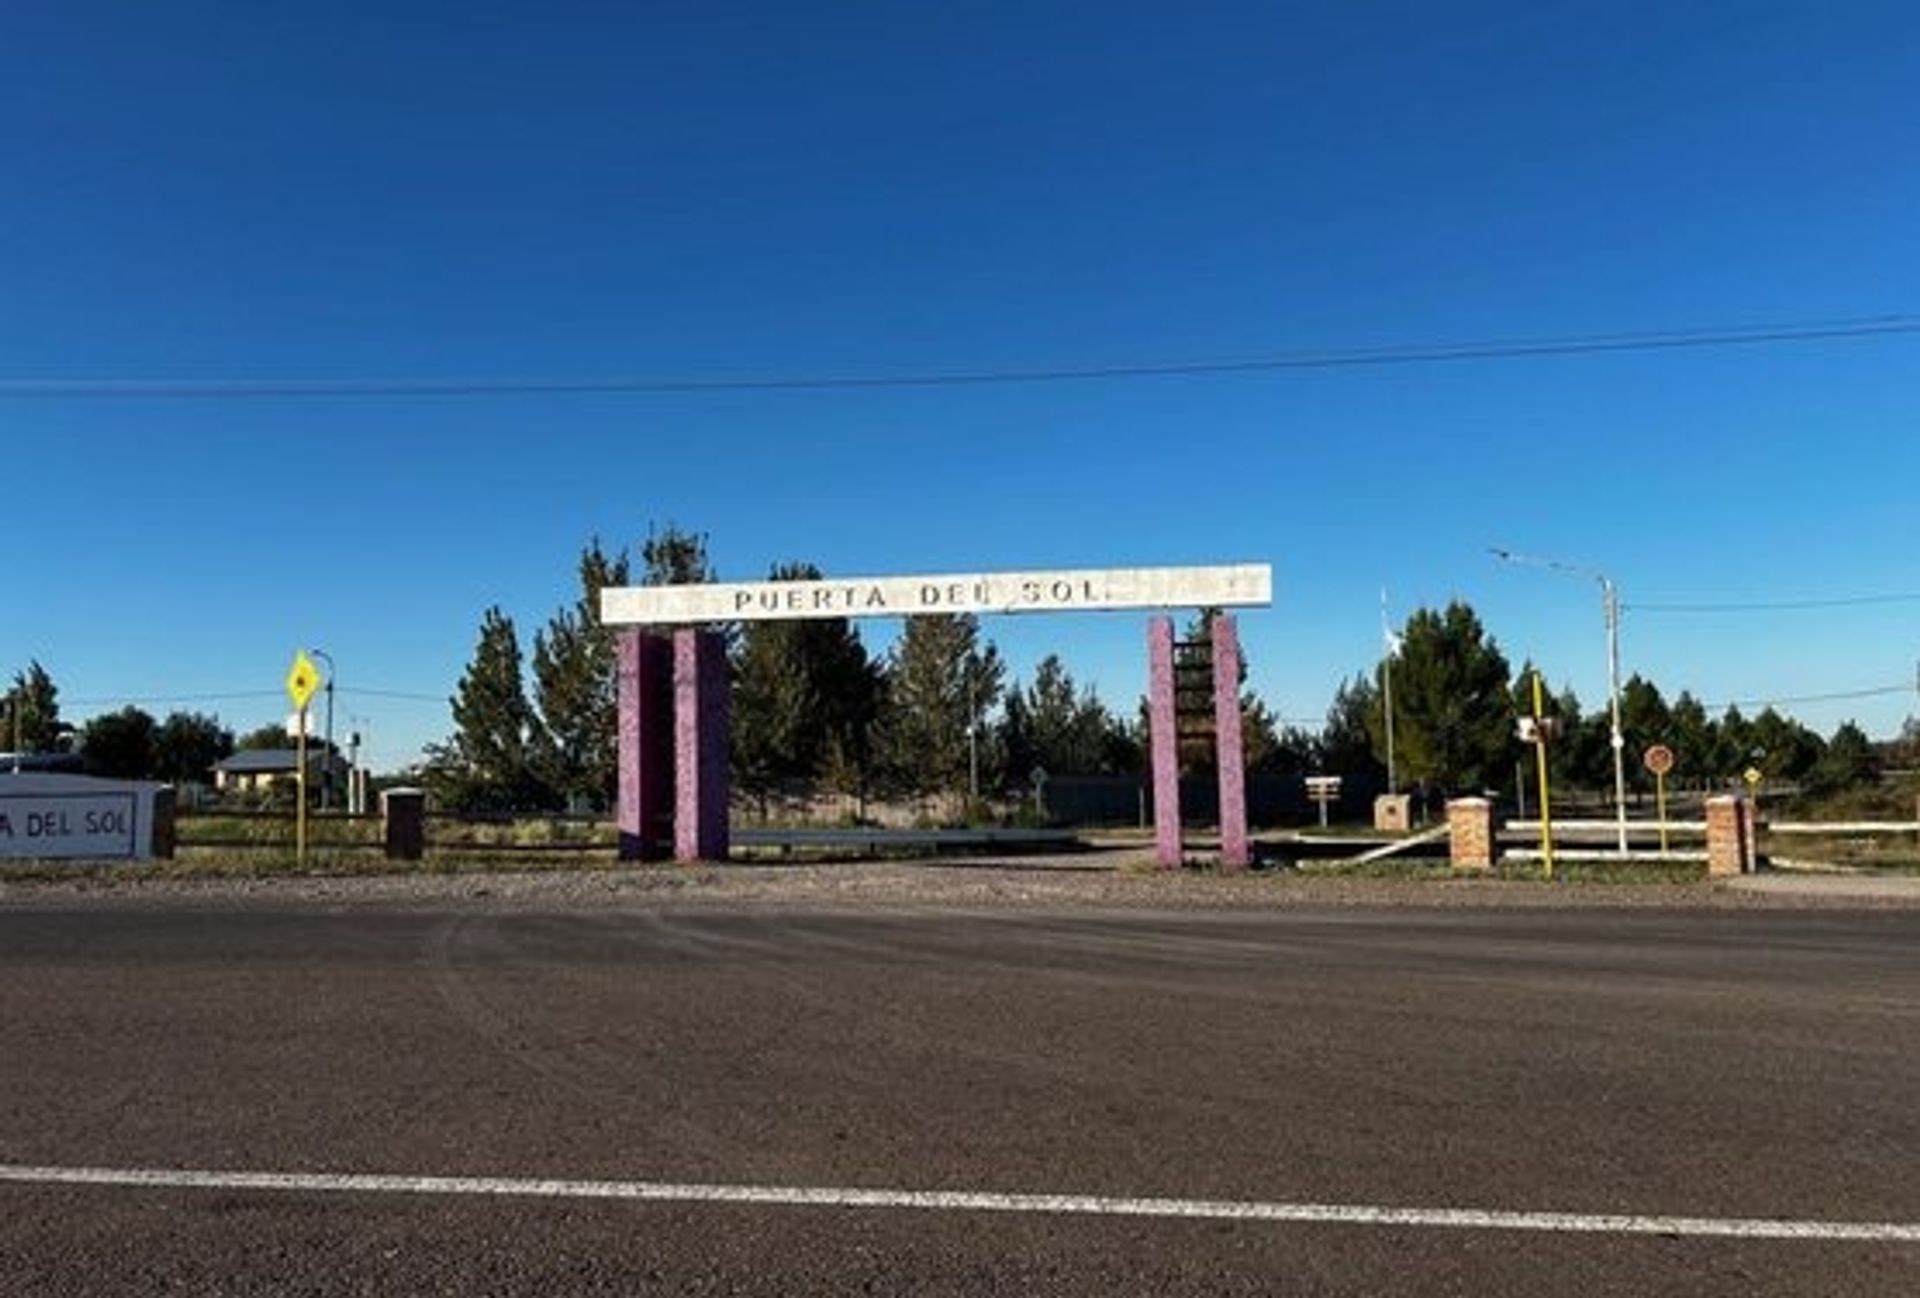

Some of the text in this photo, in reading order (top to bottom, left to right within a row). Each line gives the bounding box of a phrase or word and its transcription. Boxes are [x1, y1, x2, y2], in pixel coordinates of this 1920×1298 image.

[734, 585, 886, 612] PUERTA
[921, 583, 991, 607] DEL
[27, 811, 72, 837] DEL
[85, 811, 128, 835] SOL
